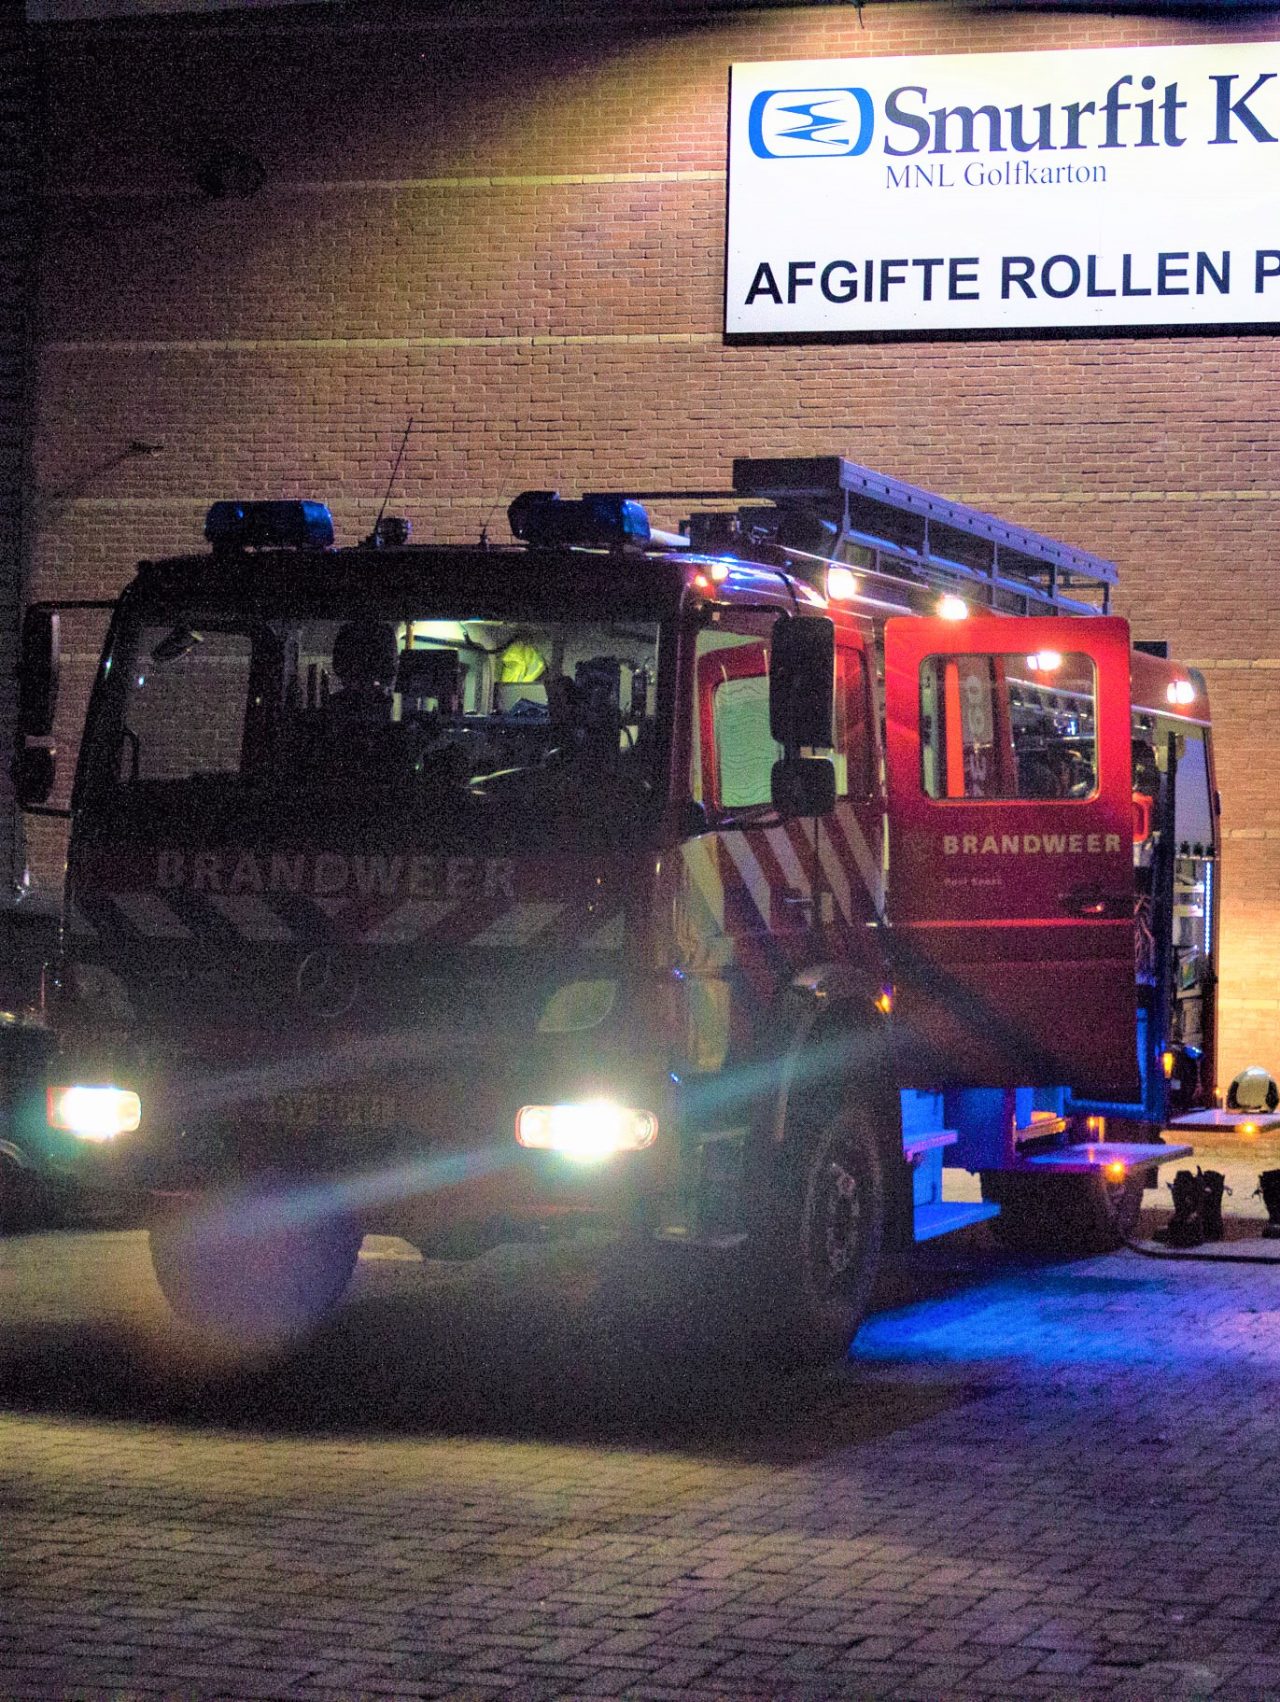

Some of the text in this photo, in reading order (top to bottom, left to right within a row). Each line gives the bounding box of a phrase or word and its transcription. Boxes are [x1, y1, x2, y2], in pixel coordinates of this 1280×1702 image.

[883, 73, 1188, 157] Smurfit
[885, 159, 1108, 190] MNL Golfkarton
[744, 256, 980, 306] AFGIFTE
[1000, 250, 1231, 304] ROLLEN
[942, 832, 1122, 856] BRANDWEER
[154, 850, 516, 897] BRANDWEER
